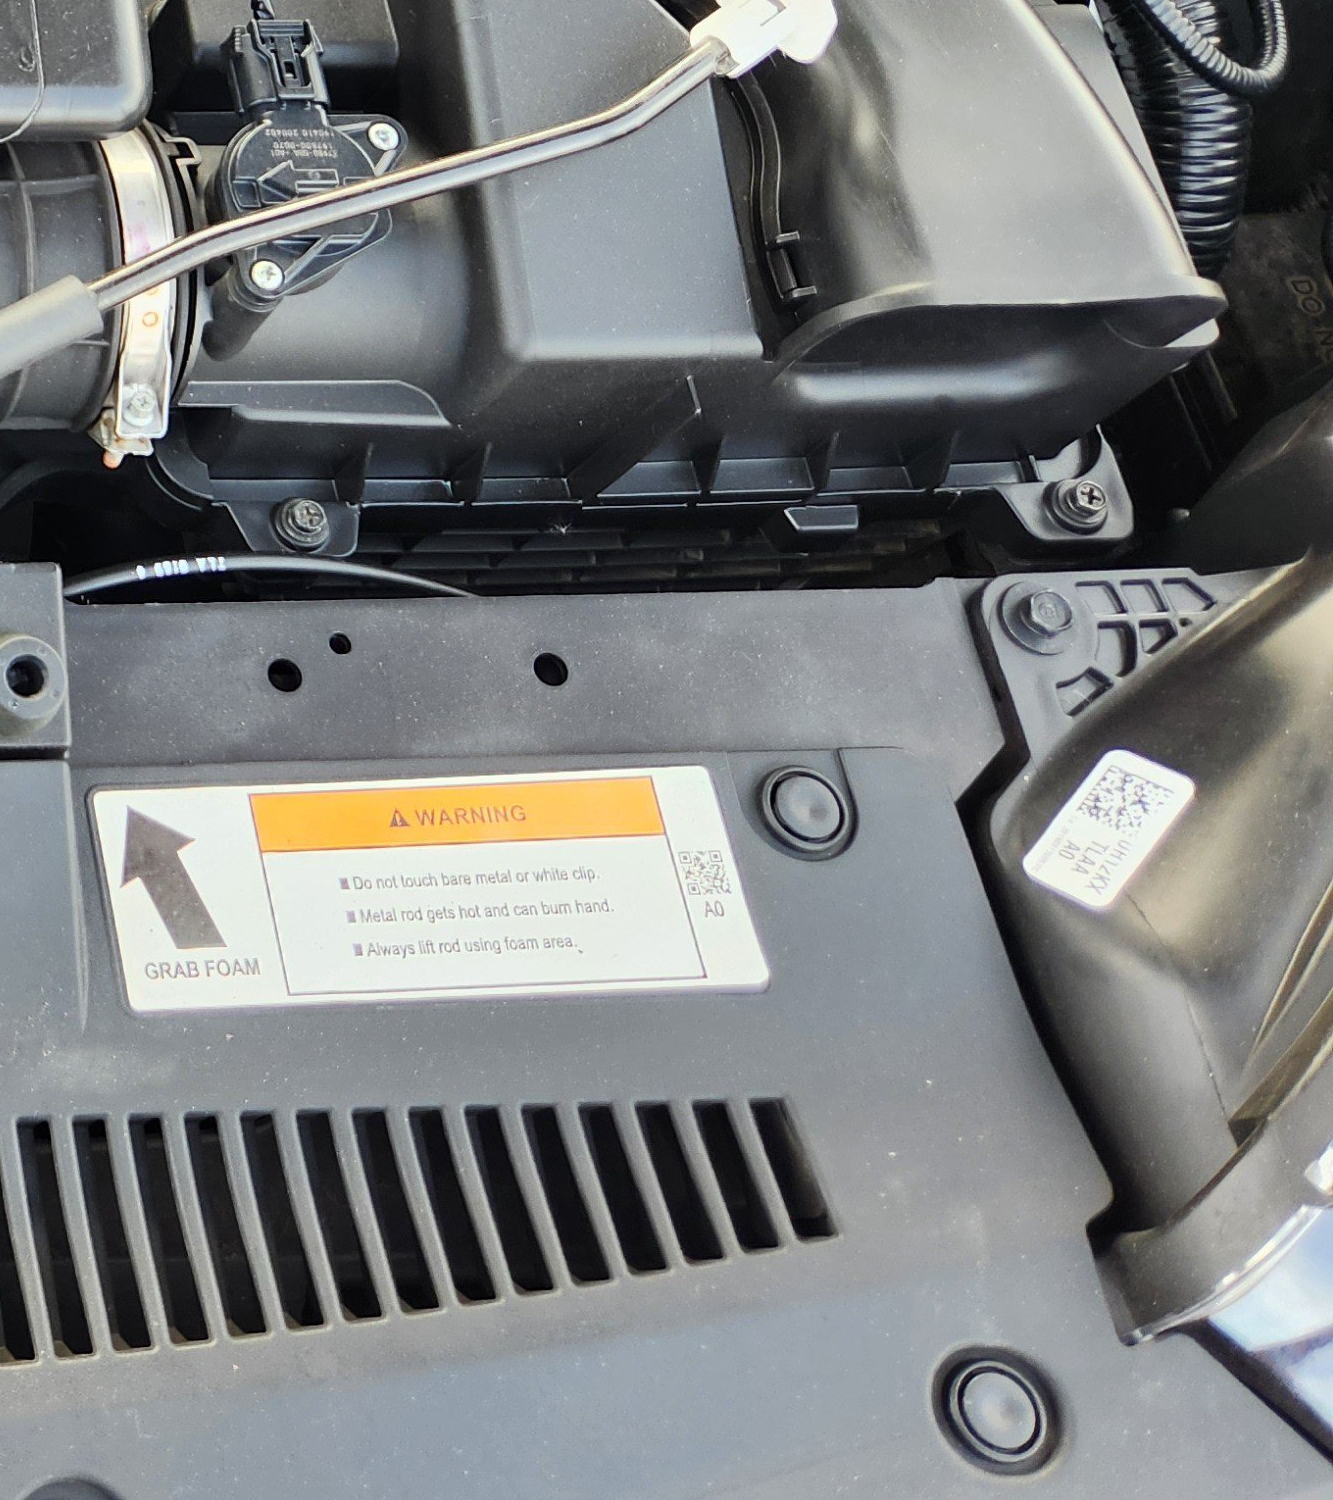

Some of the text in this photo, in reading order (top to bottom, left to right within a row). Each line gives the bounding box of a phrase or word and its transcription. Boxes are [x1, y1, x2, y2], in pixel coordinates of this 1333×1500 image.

[415, 804, 527, 827] WARNING
[1069, 839, 1110, 876] TLAA
[353, 865, 600, 891] Do not touch bare metal or white clip.
[360, 898, 614, 924] Metal rod gets hot and can burn hand.
[367, 935, 578, 960] Always lift rod using foam area.
[144, 956, 261, 980] GRAB FOAM
